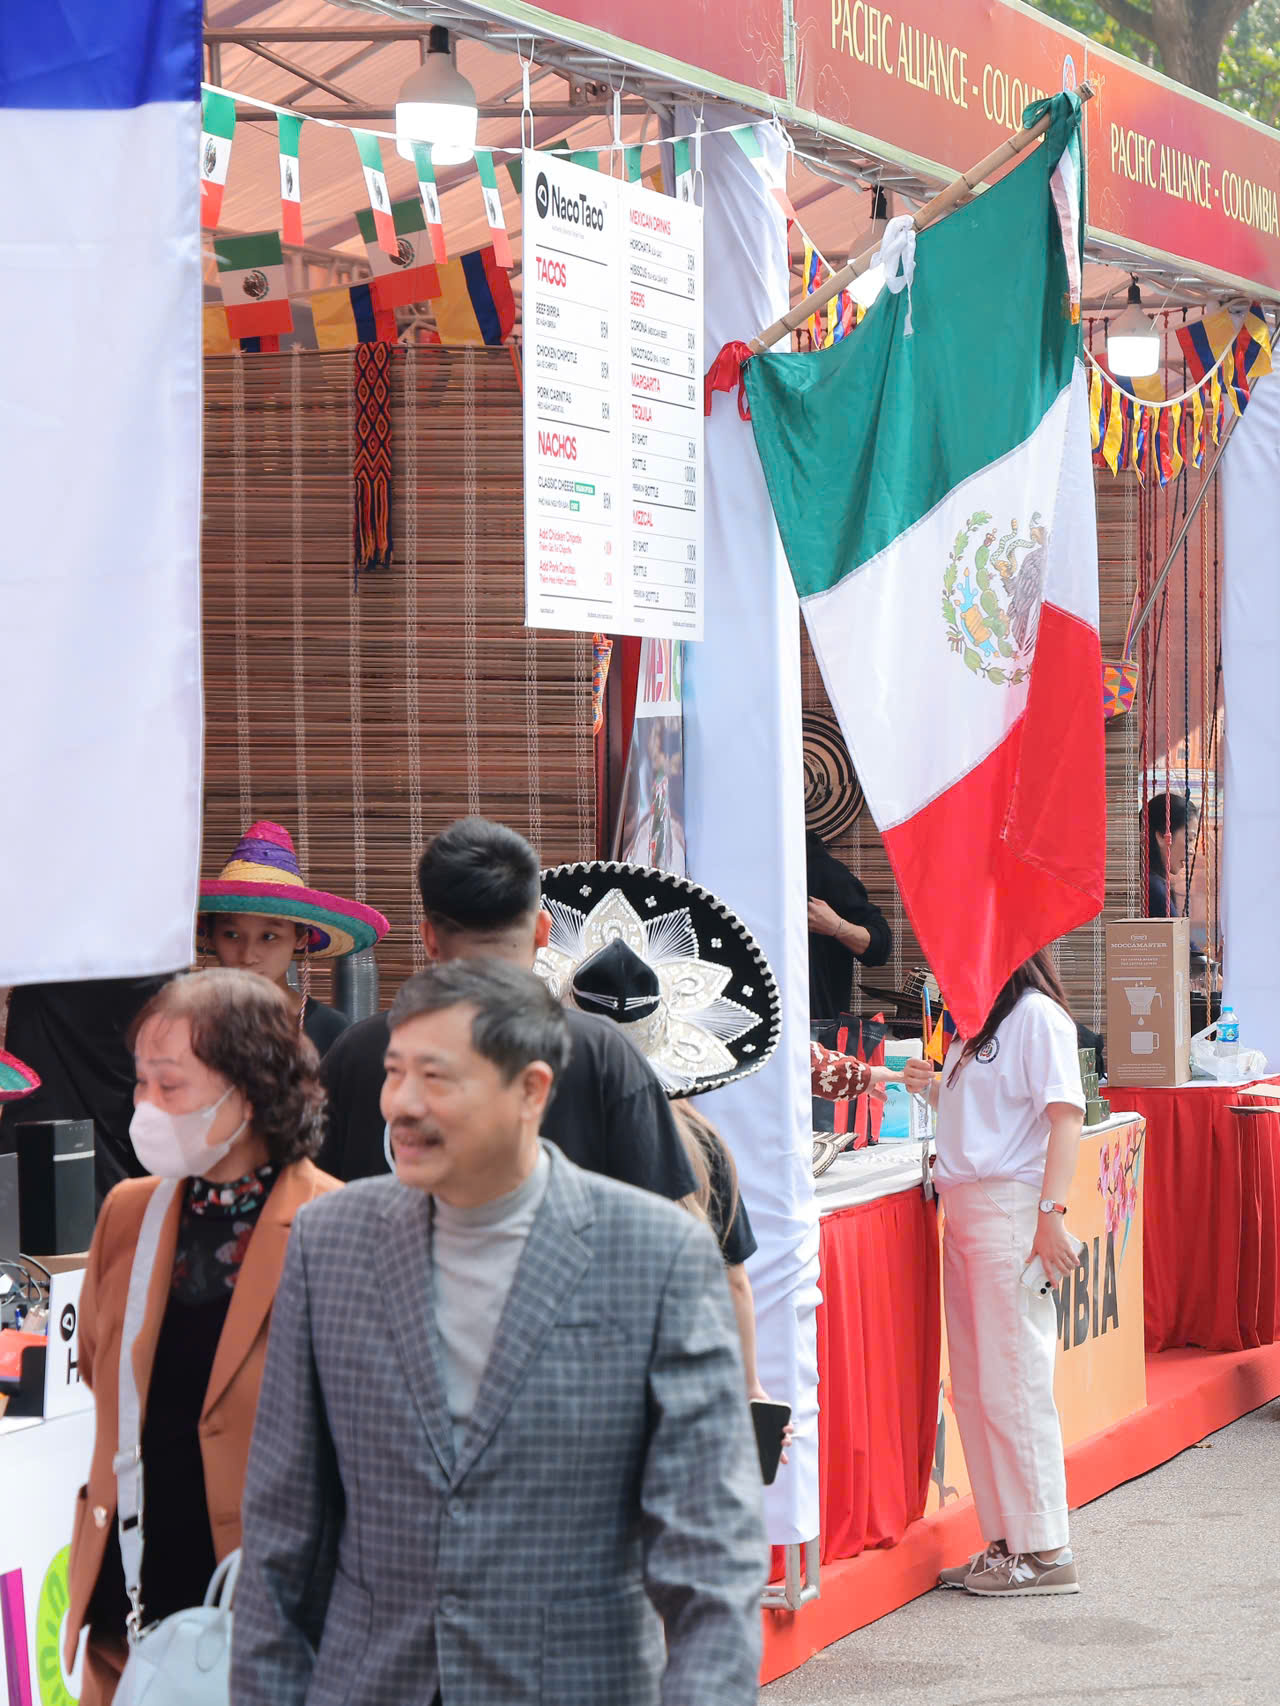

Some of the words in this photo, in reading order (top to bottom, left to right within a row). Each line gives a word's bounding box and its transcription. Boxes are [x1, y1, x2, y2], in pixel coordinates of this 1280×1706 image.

[831, 0, 893, 75] PACIFIC
[897, 21, 968, 110] ALLIANCE
[983, 62, 1049, 144] COLO
[1111, 121, 1156, 189] PACIFIC
[1159, 143, 1212, 210] ALLIANCE
[1222, 169, 1280, 238] COLOMBIA
[552, 184, 604, 232] NacoTaco
[536, 256, 567, 288] TACOS
[630, 290, 646, 308] BEERS
[632, 403, 653, 422] TEQUILA
[538, 430, 577, 461] NACHOS
[538, 475, 557, 490] CLASSIC
[557, 479, 575, 493] CHEESE
[1051, 1231, 1119, 1352] MBIA
